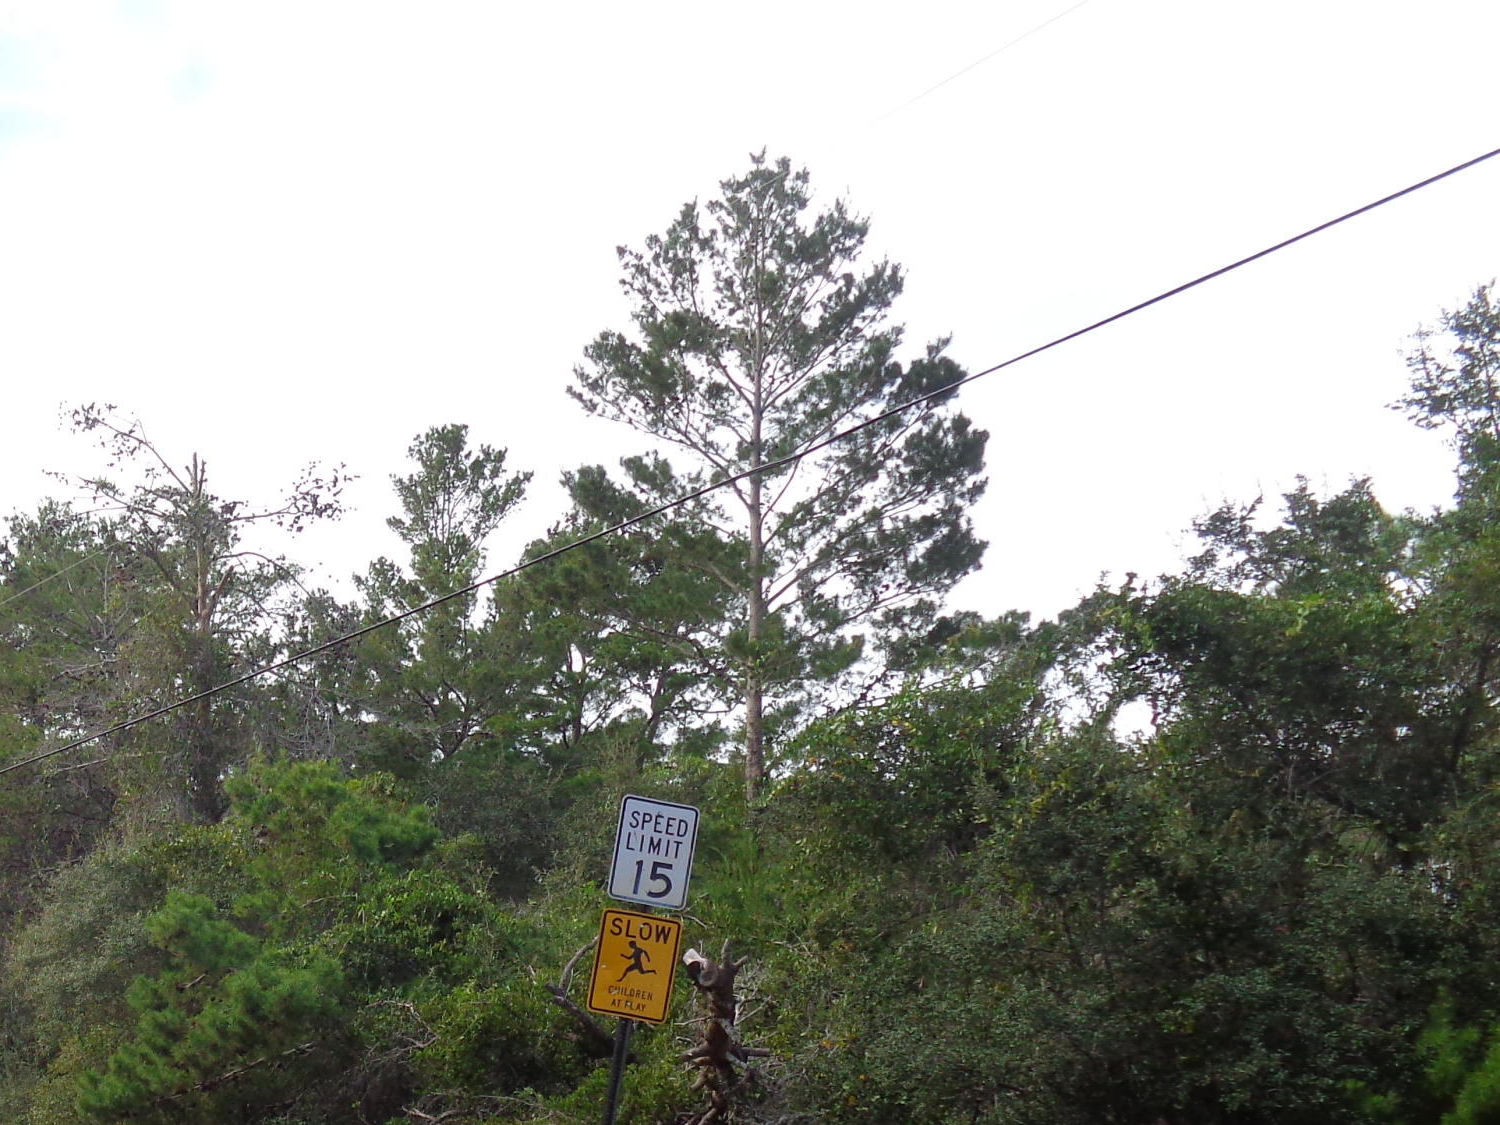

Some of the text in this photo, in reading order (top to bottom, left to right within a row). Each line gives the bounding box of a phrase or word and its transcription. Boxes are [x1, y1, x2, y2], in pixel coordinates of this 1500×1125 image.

[629, 811, 688, 838] SPEED
[626, 831, 683, 859] LIMIT
[632, 859, 673, 898] 15
[610, 917, 671, 945] SLOW
[608, 985, 653, 1001] CHILDREN
[611, 998, 621, 1007] AT
